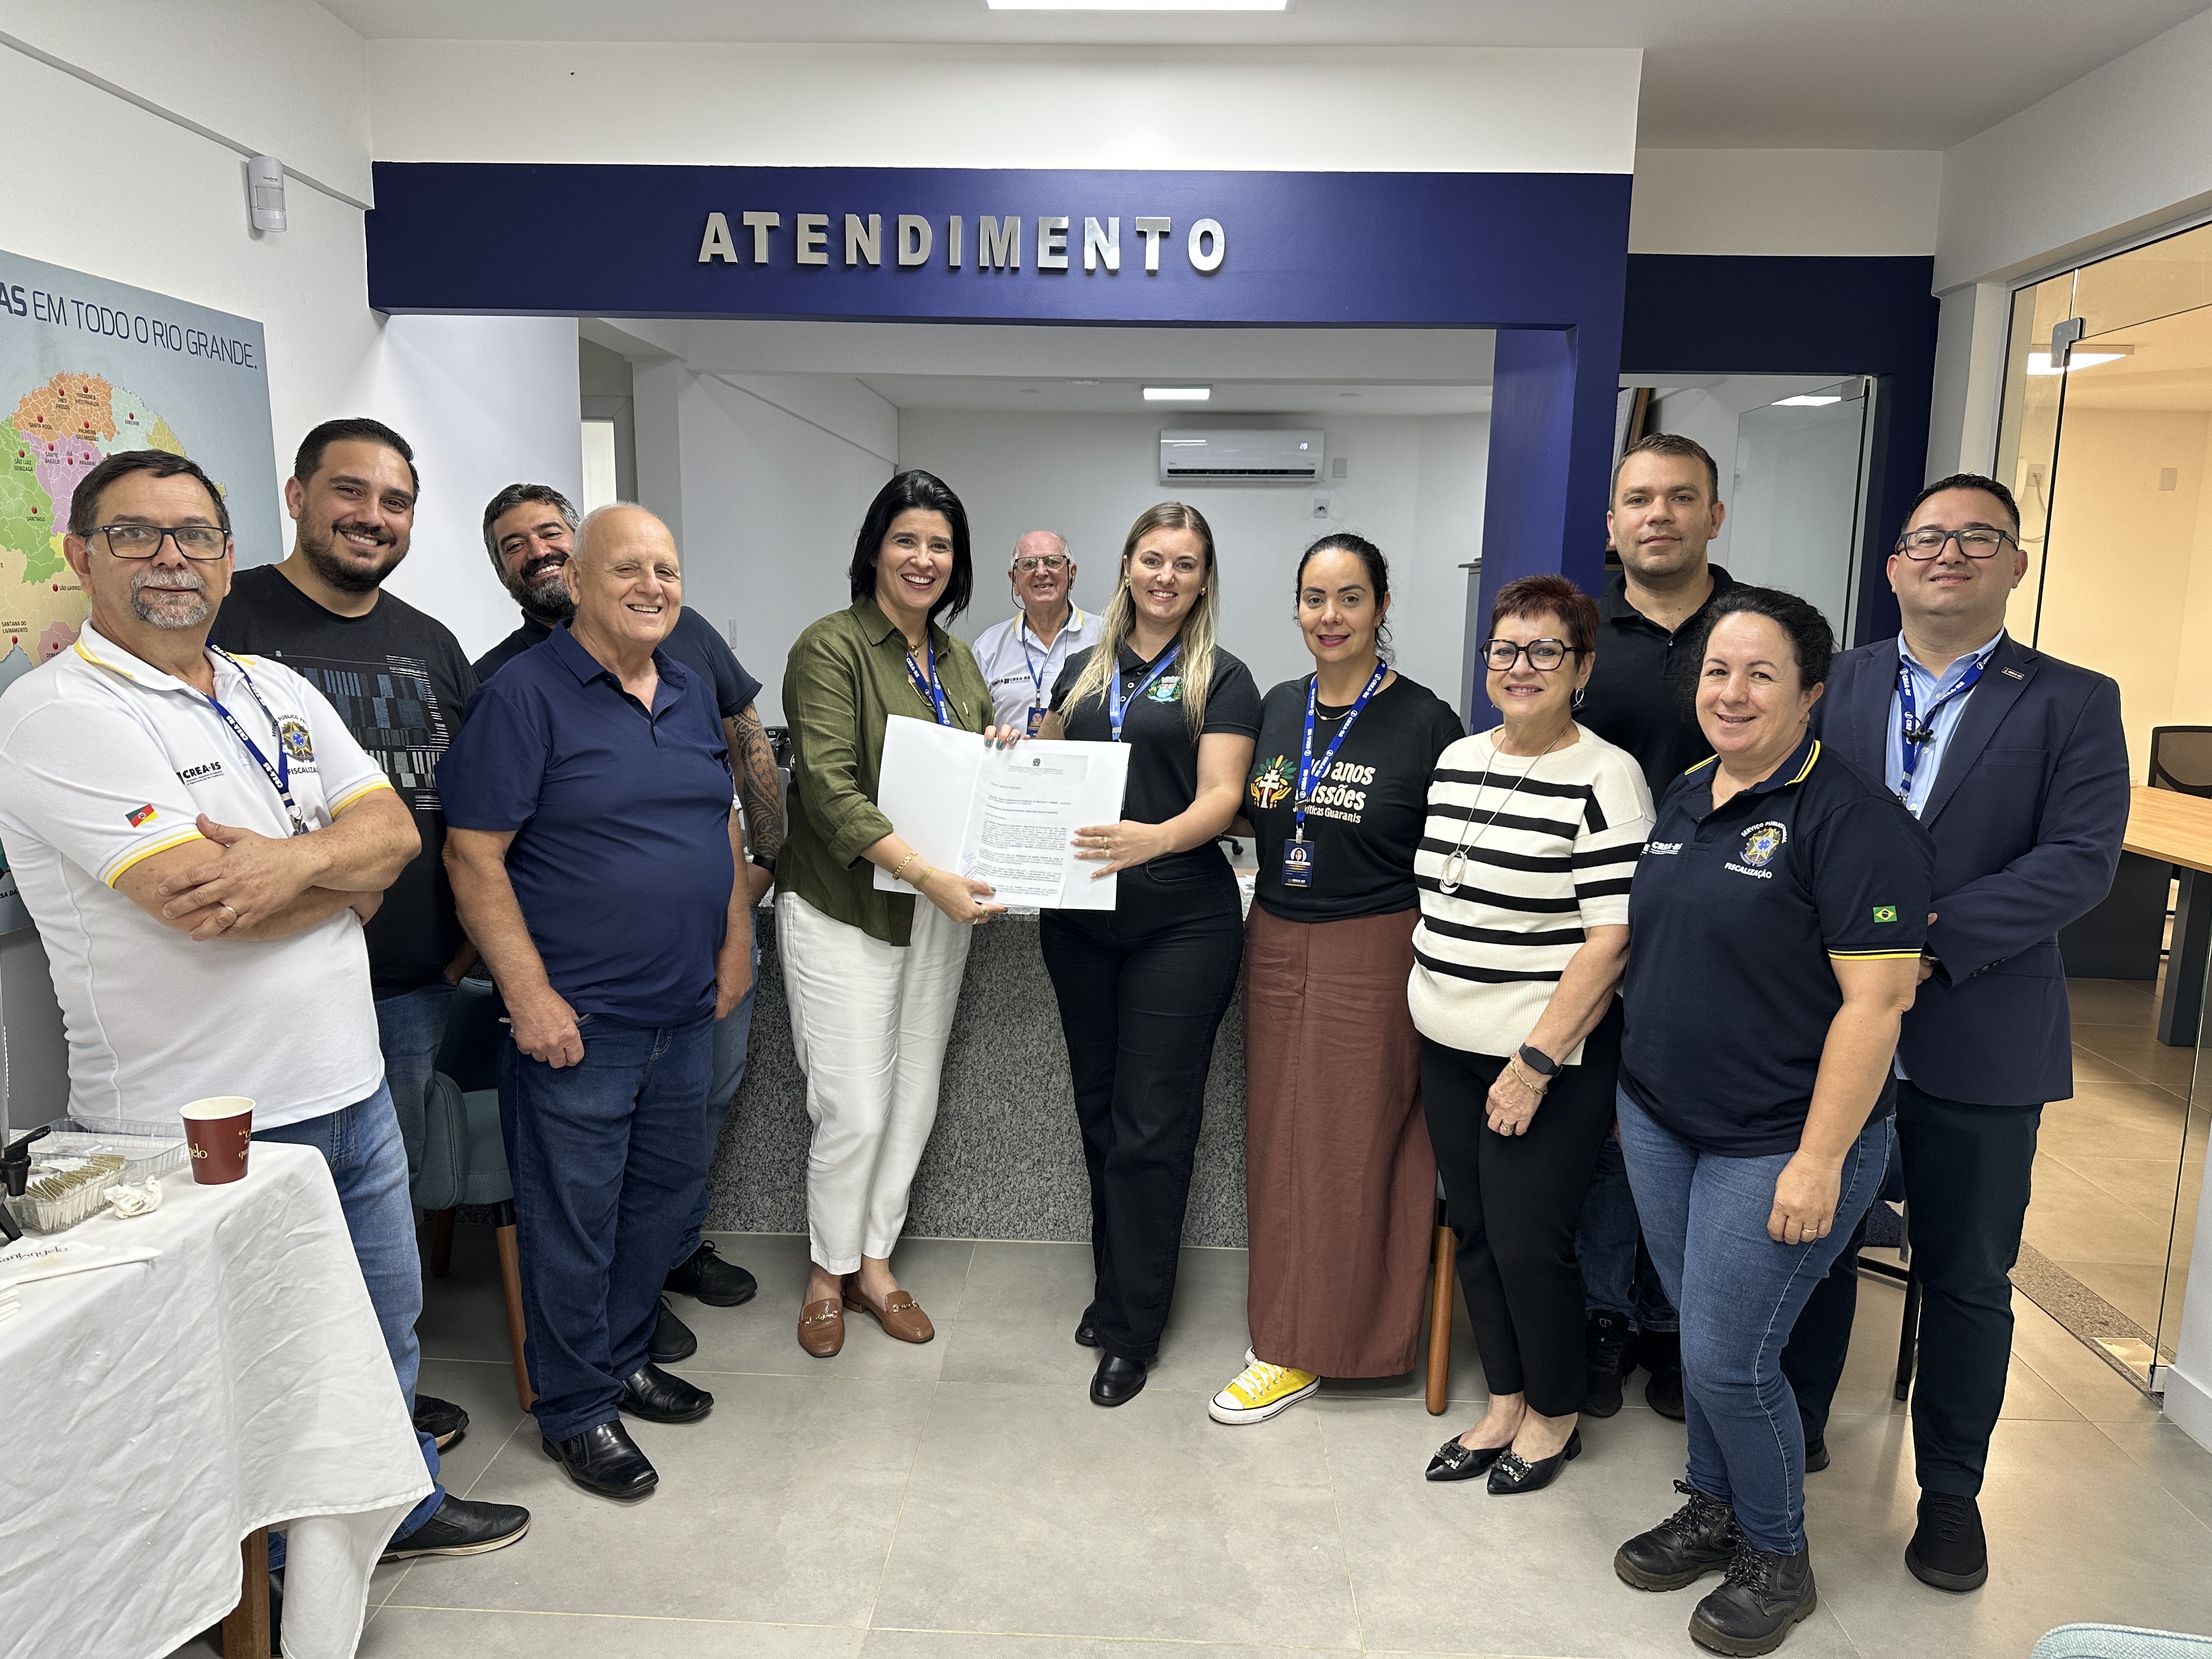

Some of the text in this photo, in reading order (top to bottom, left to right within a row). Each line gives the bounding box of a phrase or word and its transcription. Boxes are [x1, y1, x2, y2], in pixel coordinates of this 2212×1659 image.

[698, 211, 1227, 272] ATENDIMENTO
[33, 290, 67, 326] EM
[71, 299, 129, 340] TODO
[134, 316, 149, 344] O
[152, 319, 182, 352] RIO
[186, 329, 257, 369] GRANDE.
[906, 657, 920, 678] CREA-RS
[1338, 716, 1353, 738] CREA-RS
[182, 761, 222, 779] CREA-RS
[1330, 761, 1376, 786] anos
[1295, 781, 1367, 811] issões
[1324, 807, 1362, 823] Guaranis
[1741, 822, 1764, 837] SERVIÇO
[1724, 862, 1773, 879] FISCALIZAÇÃO
